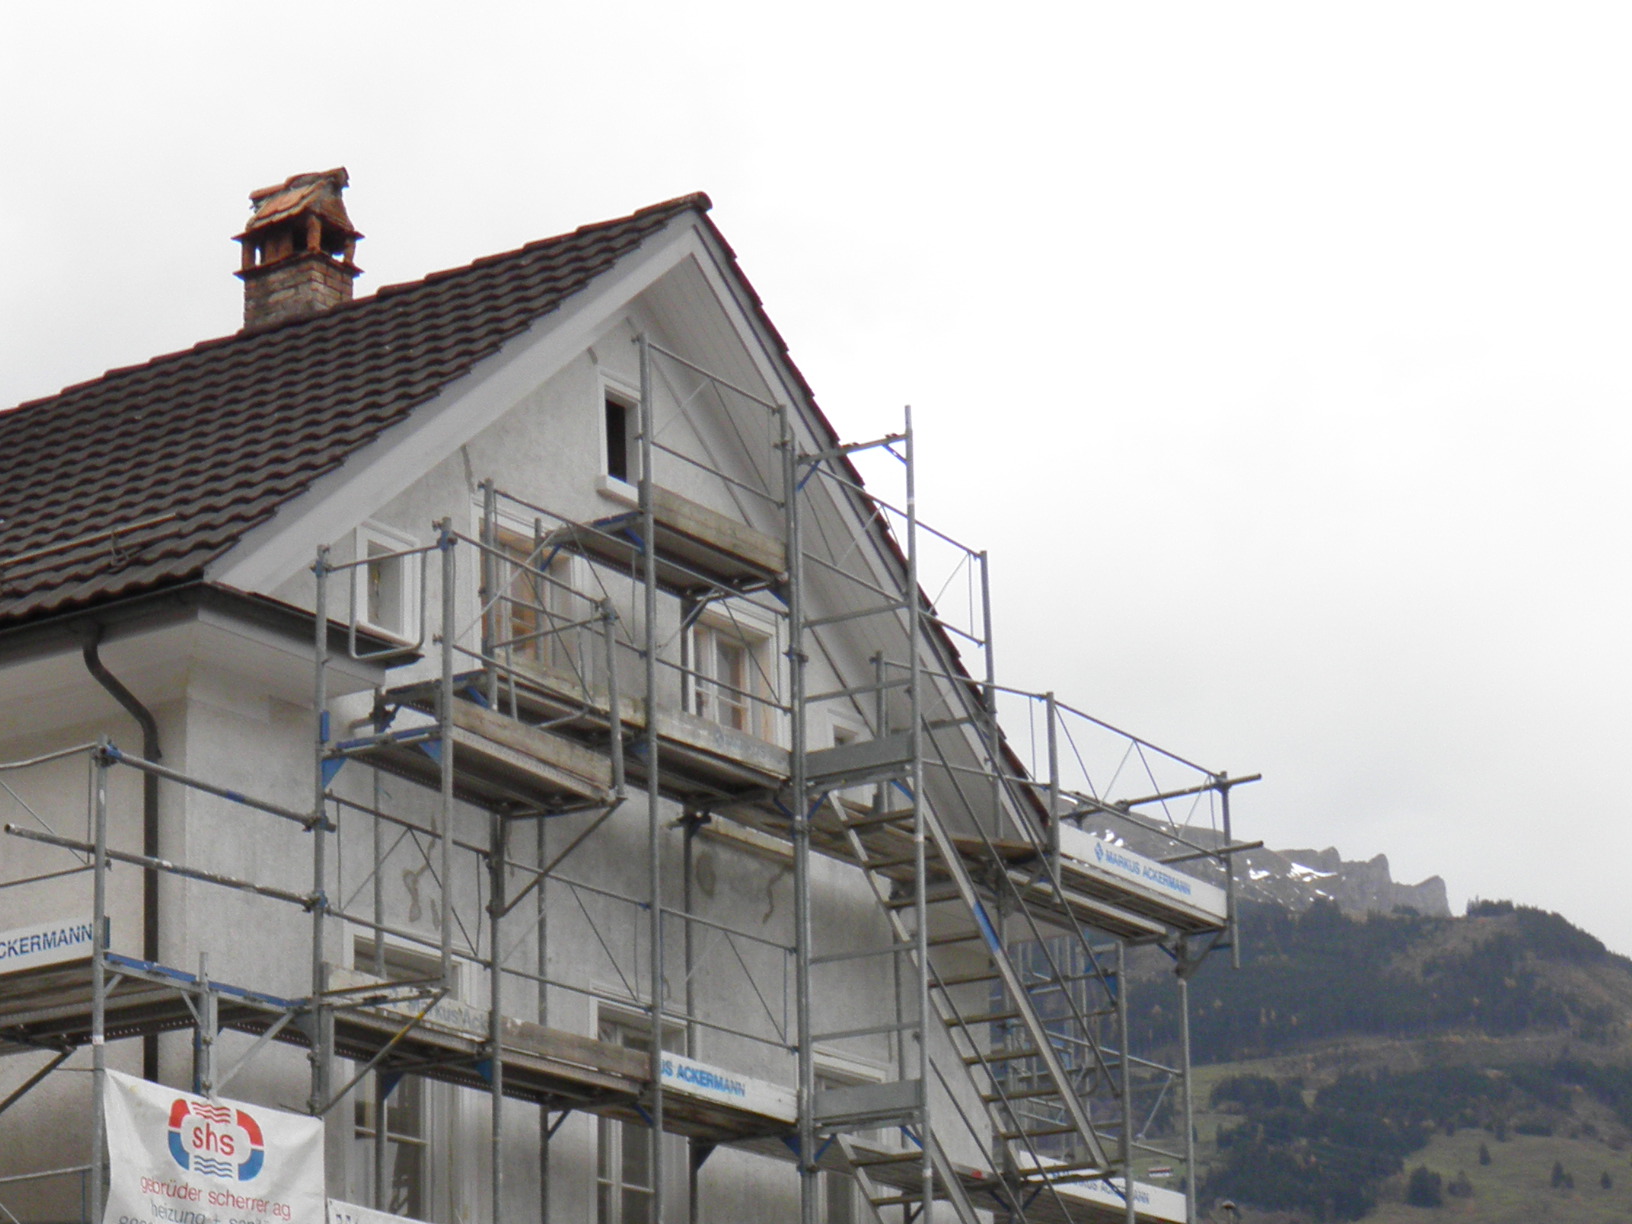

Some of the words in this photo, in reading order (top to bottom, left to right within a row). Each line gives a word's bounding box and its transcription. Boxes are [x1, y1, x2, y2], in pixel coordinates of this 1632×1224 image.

[1106, 850, 1140, 876] MARKUS
[1143, 864, 1192, 896] ACKERMANN
[677, 1064, 746, 1097] ACKERMANN
[192, 1122, 234, 1156] shs
[140, 1175, 202, 1202] gebrüder
[208, 1189, 270, 1214] scherrer
[272, 1203, 291, 1221] ag
